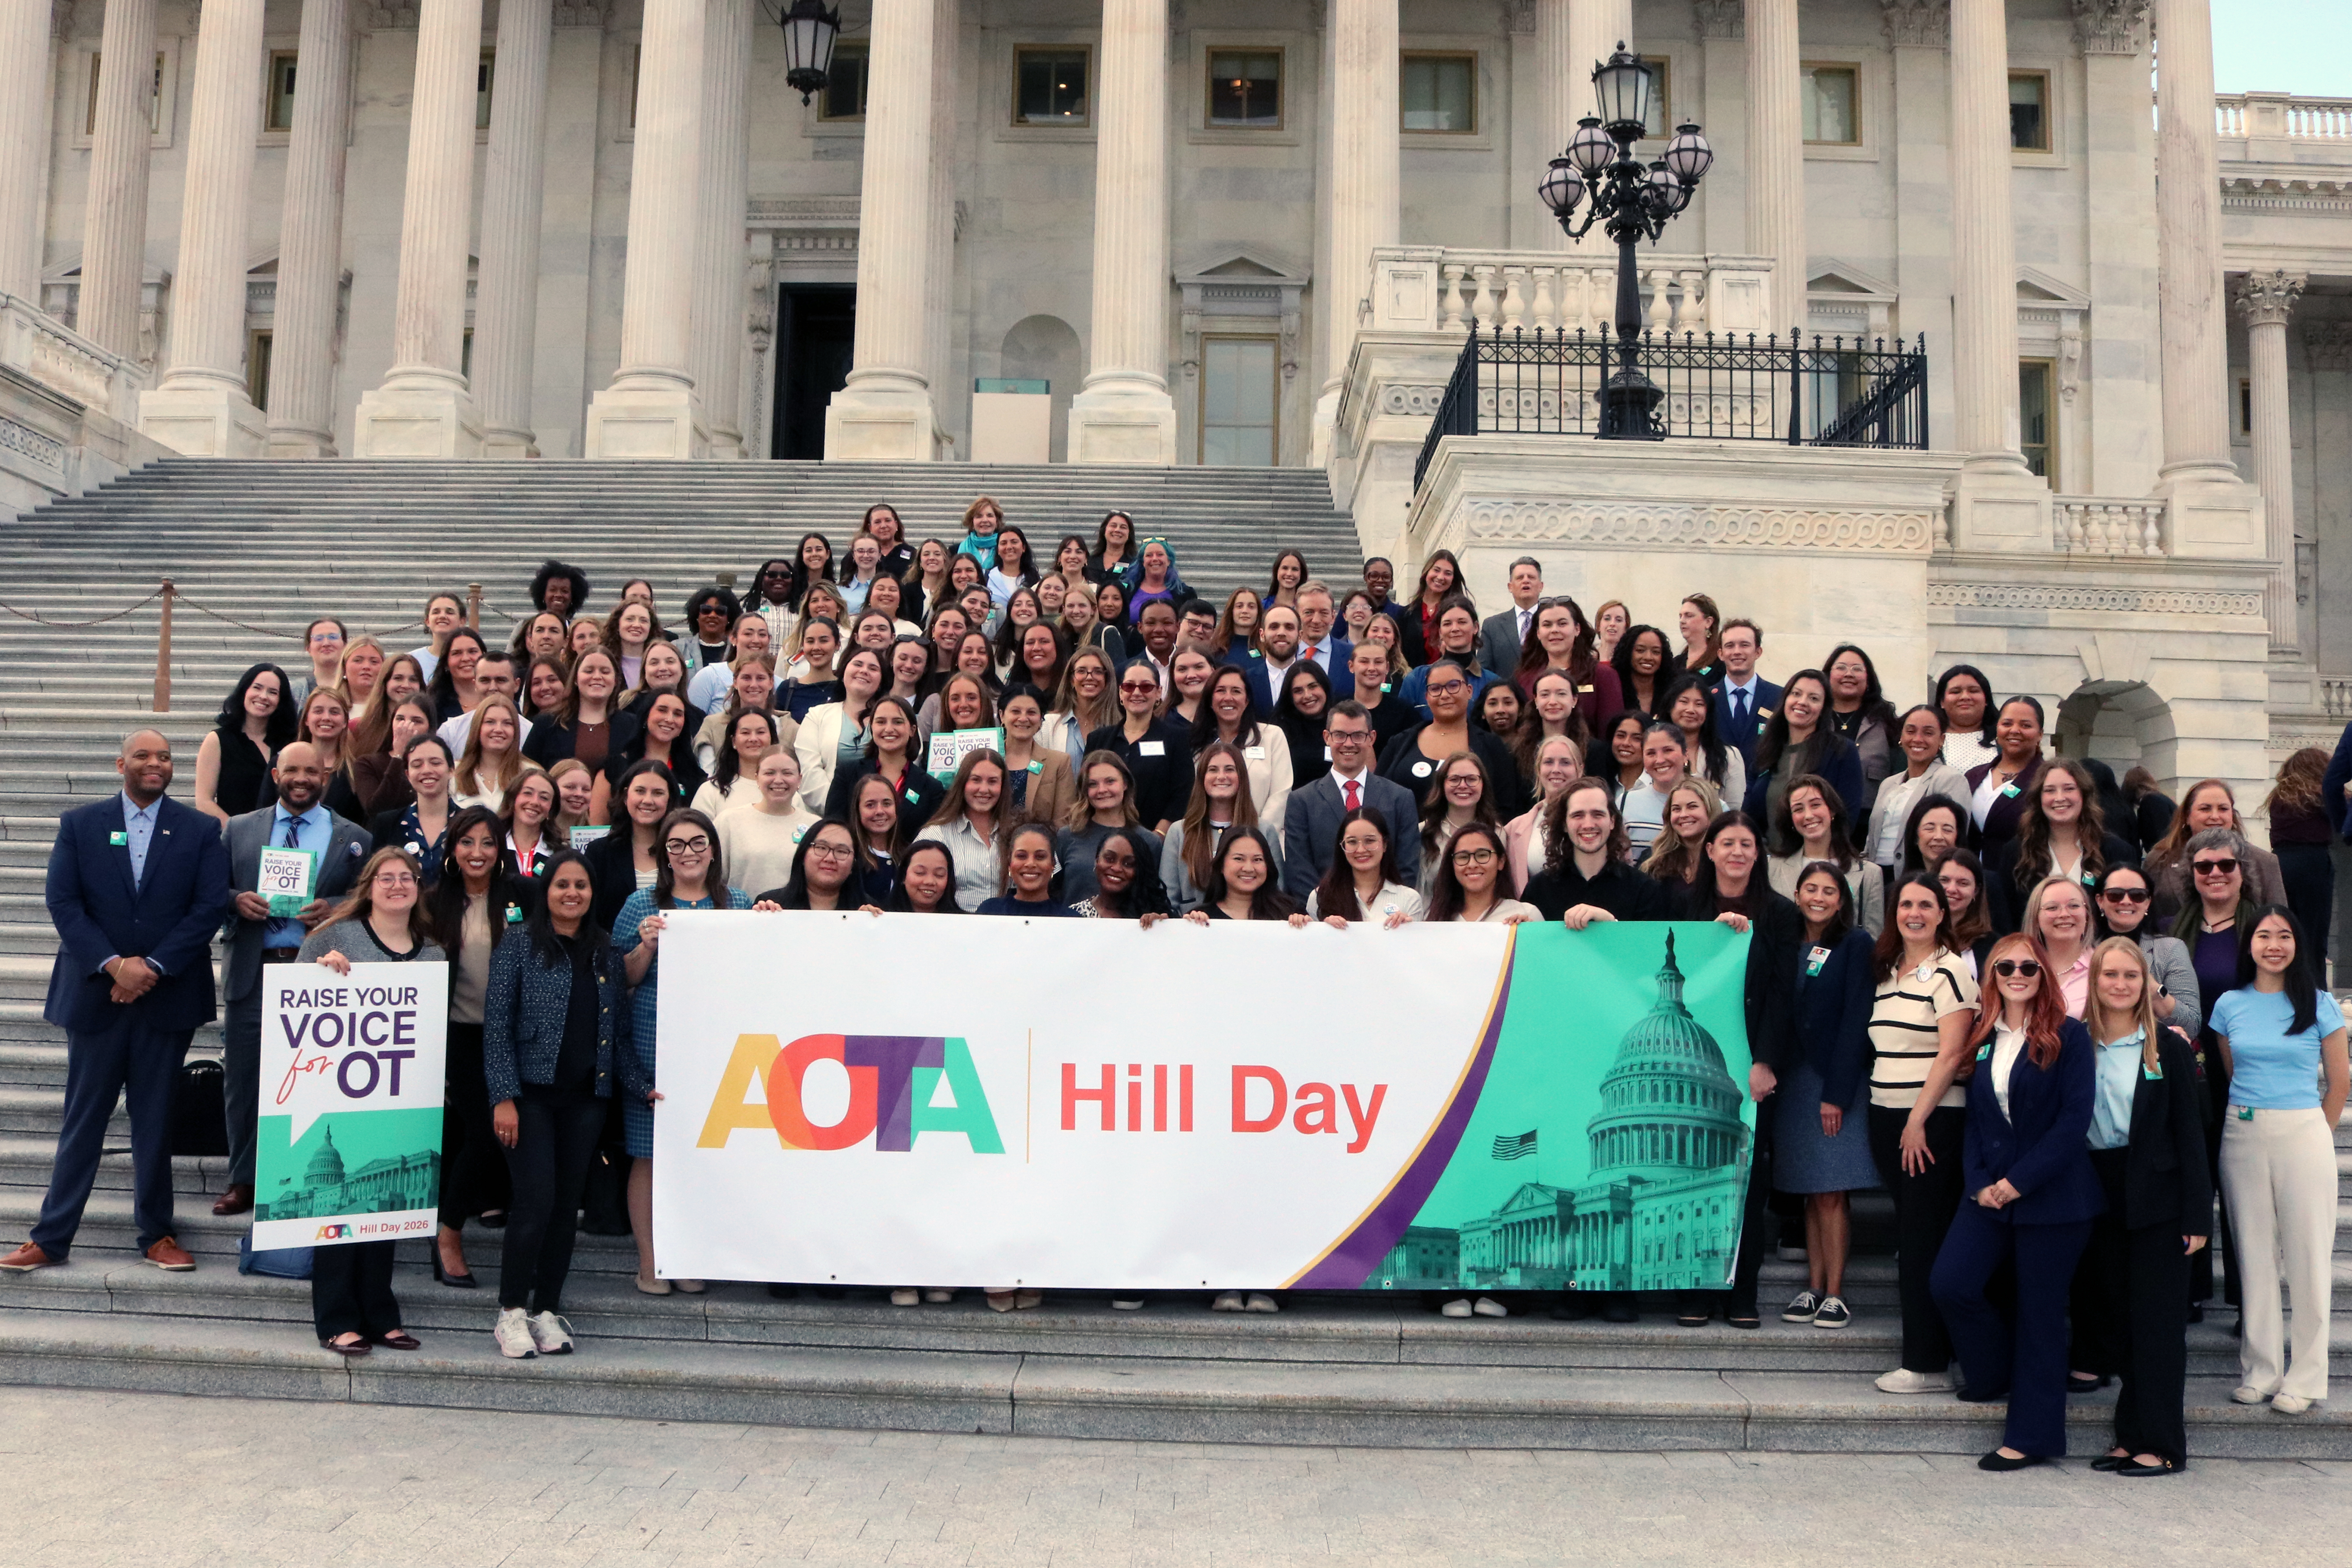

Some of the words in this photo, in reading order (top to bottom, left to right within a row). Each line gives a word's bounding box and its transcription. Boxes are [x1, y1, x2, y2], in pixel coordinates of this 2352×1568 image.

[944, 756, 955, 766] O
[265, 865, 301, 876] VOICE
[262, 874, 278, 887] for
[279, 876, 300, 889] OT
[281, 989, 348, 1008] RAISE
[355, 987, 417, 1006] YOUR
[280, 1011, 416, 1048] VOICE
[276, 1049, 333, 1105] for
[337, 1050, 415, 1098] OT
[696, 1033, 1005, 1155] AOTA
[1061, 1063, 1194, 1133] Hill
[1231, 1065, 1388, 1154] Day
[315, 1223, 353, 1240] AOTA
[360, 1224, 377, 1234] Hill
[381, 1223, 401, 1233] Day
[405, 1220, 428, 1230] 2026
